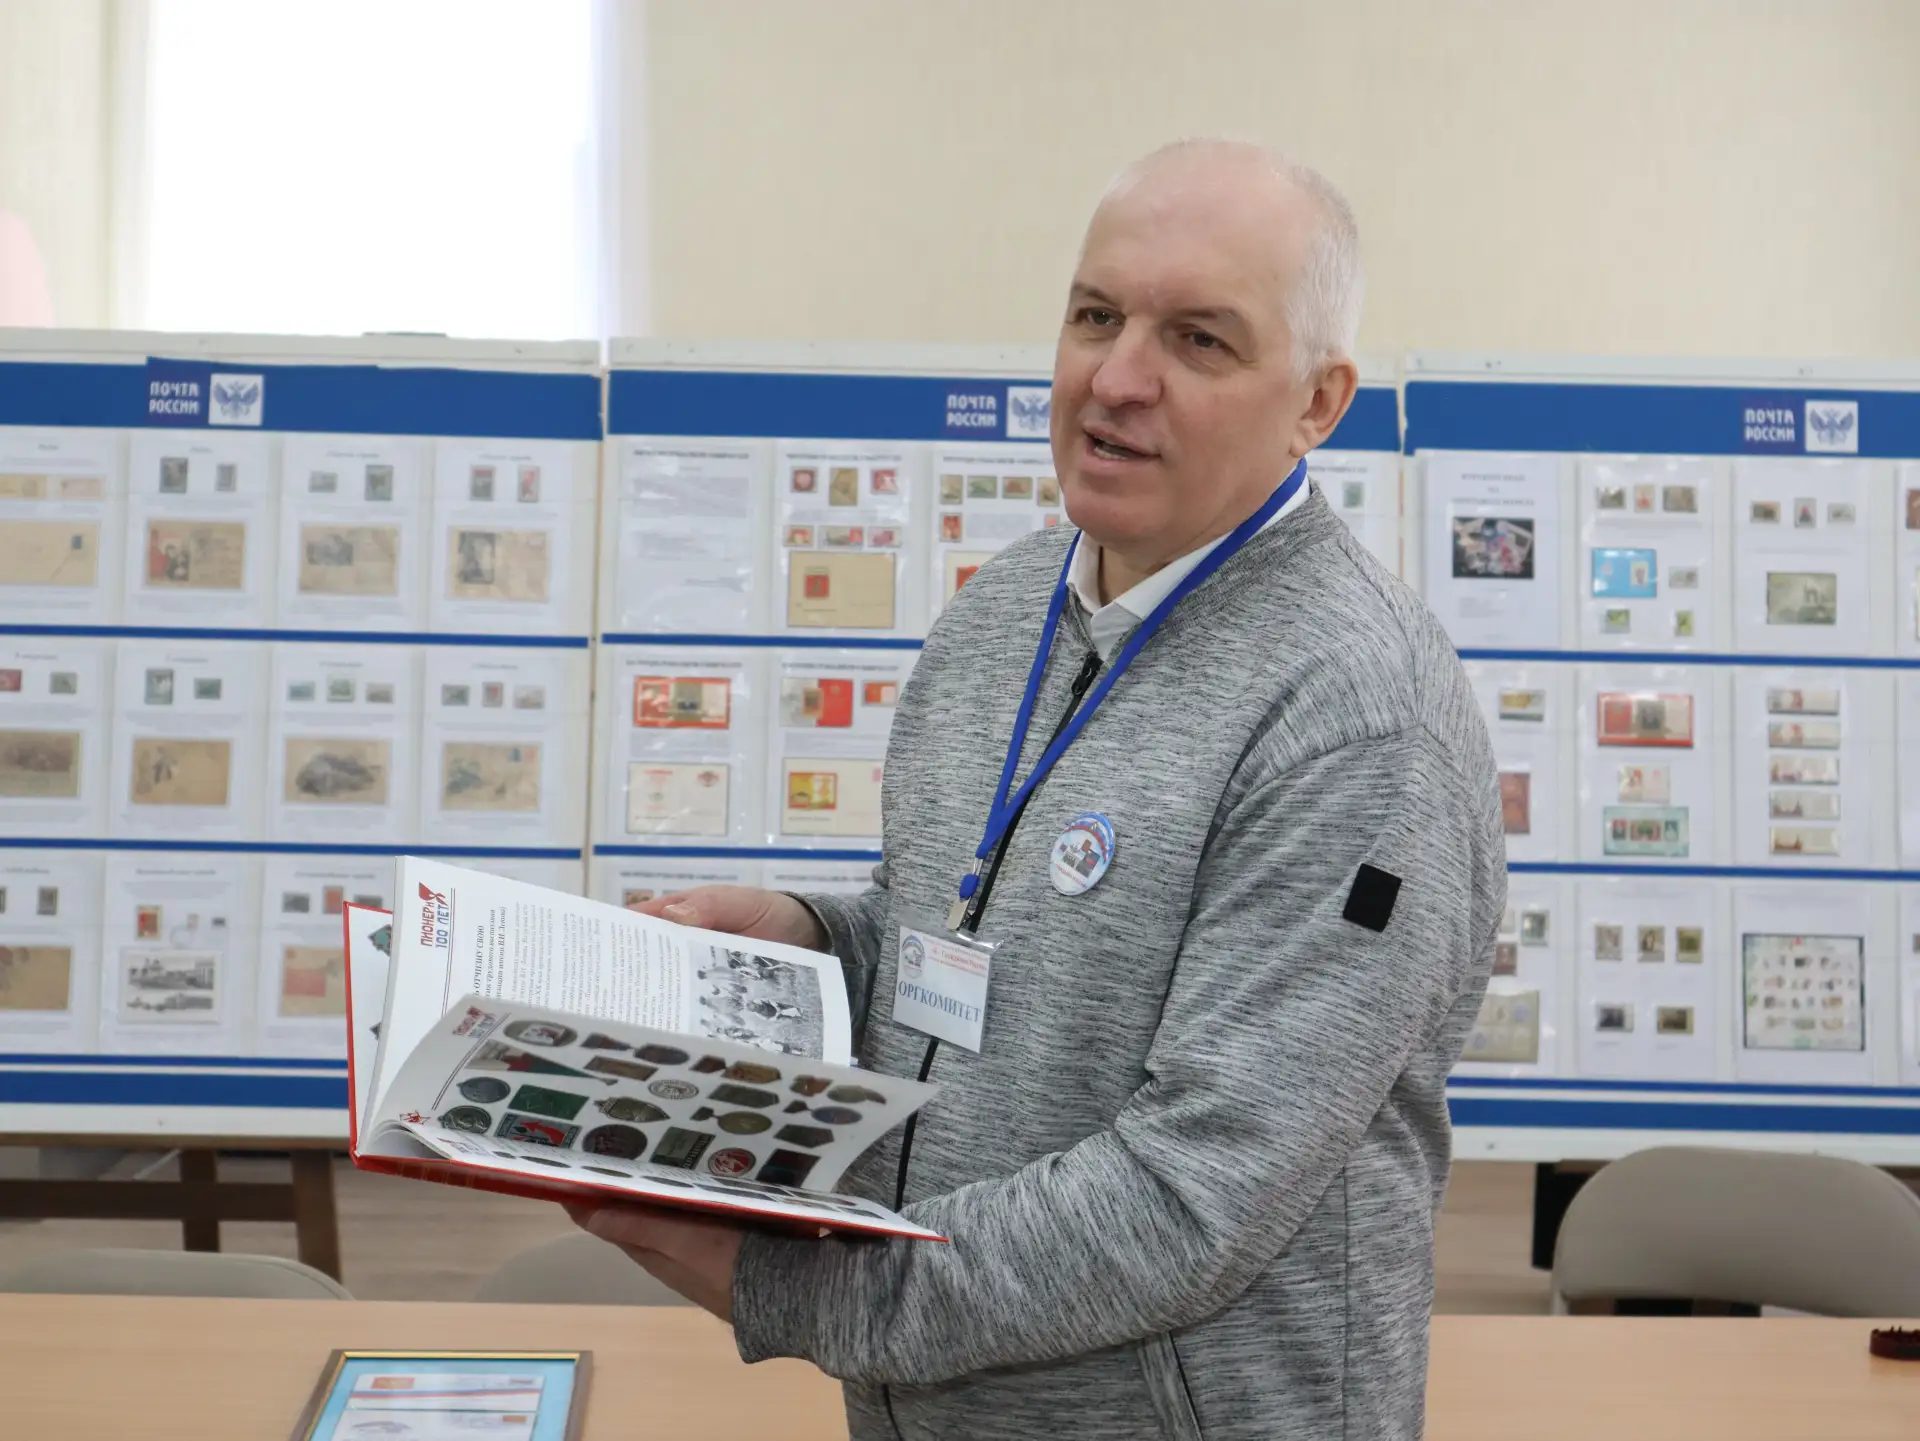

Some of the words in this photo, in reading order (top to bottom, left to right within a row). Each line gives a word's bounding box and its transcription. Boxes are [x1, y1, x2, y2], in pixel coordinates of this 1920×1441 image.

[149, 381, 199, 397] ПОЧТА
[149, 399, 199, 415] РОССИИ
[947, 394, 997, 410] ПОЧТА
[946, 412, 997, 427] РОССИИ
[1745, 408, 1795, 424] ПОЧТА
[1745, 426, 1796, 442] РОССИИ
[437, 904, 450, 925] ЛЕТ
[435, 929, 449, 949] 100
[476, 925, 485, 949] СВОЮ
[898, 980, 982, 1023] ОРГКОМИТЕТ
